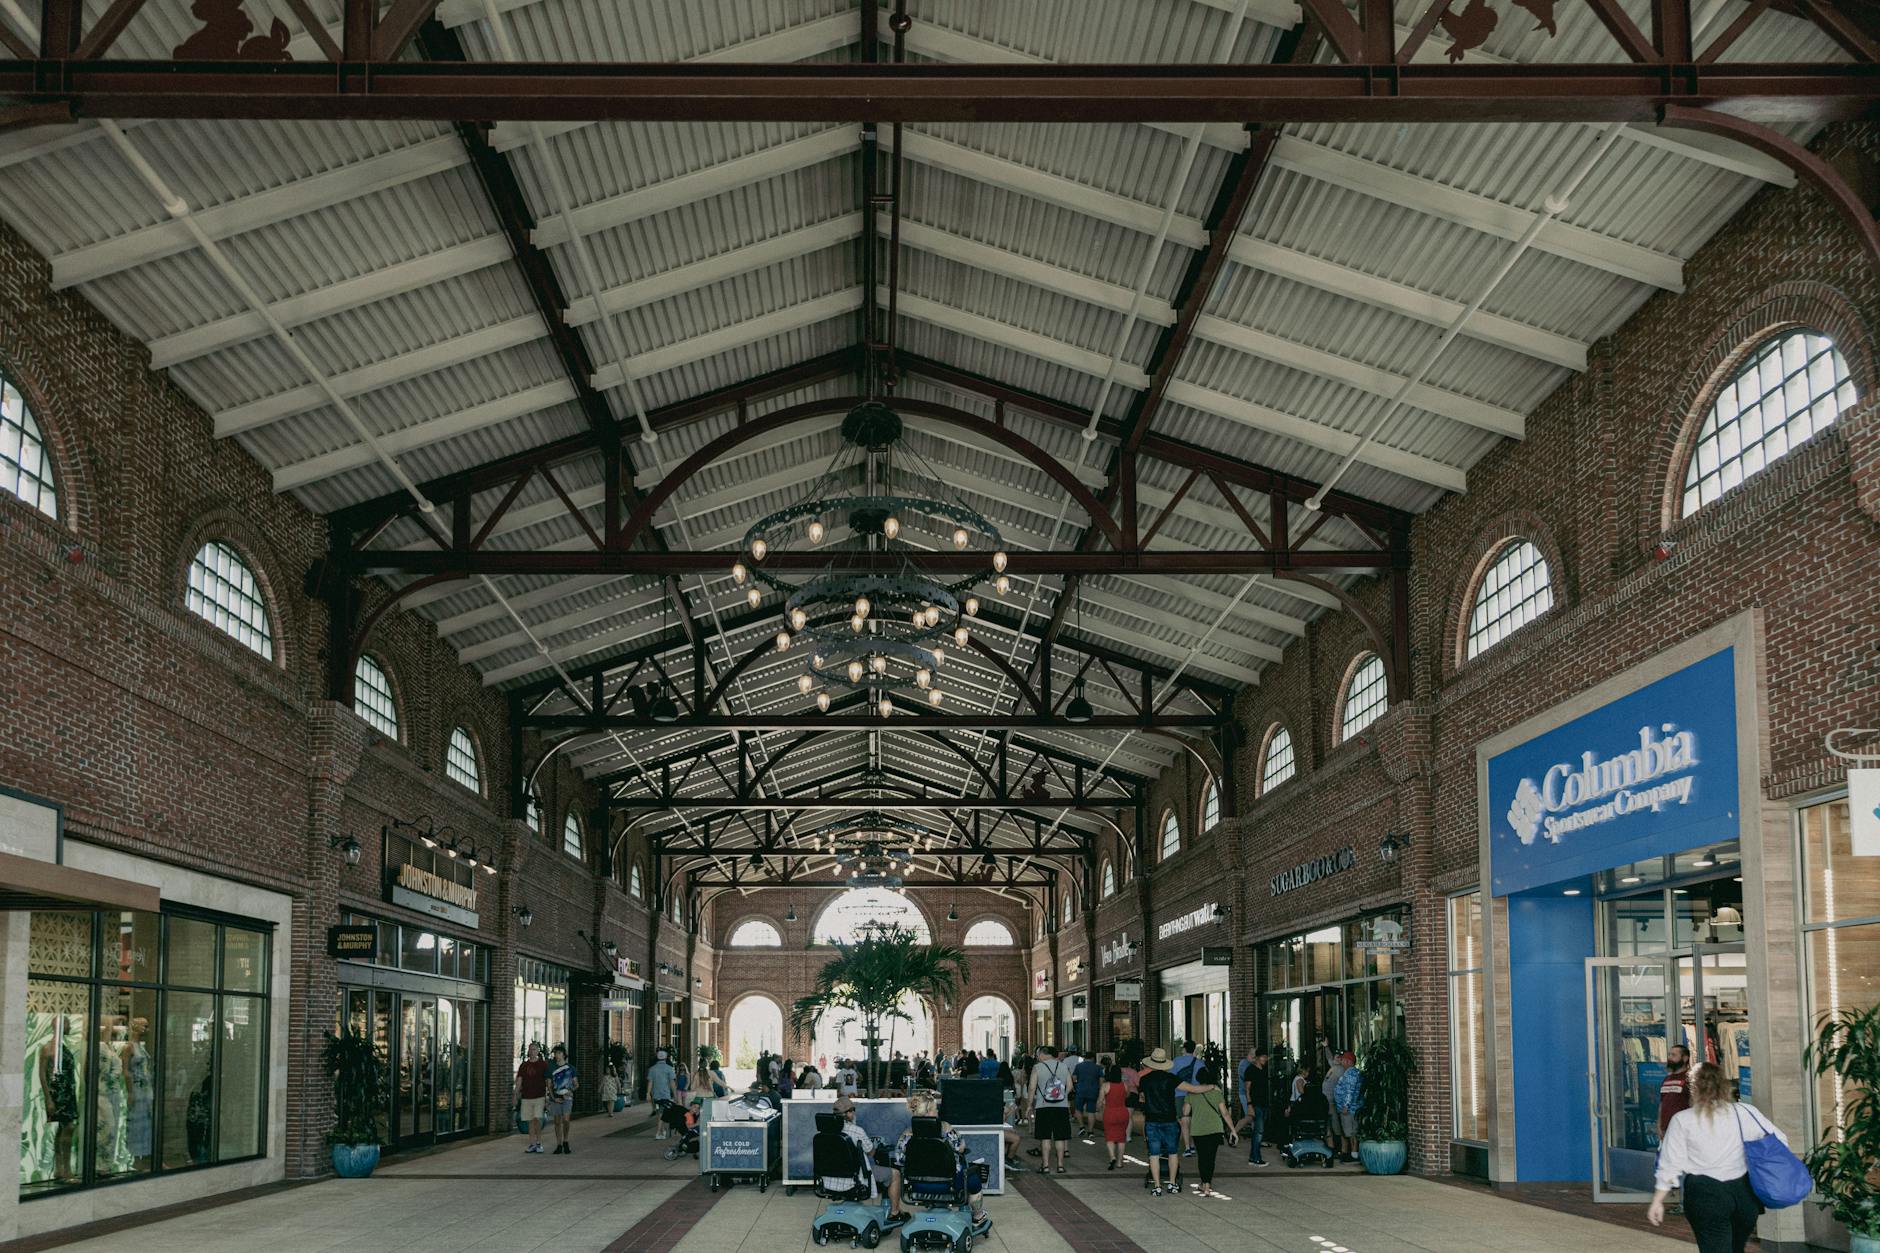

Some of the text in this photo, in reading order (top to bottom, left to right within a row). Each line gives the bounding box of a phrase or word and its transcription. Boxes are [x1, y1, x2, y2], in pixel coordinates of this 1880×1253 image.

[1543, 723, 1696, 812] Columbia
[1544, 776, 1695, 844] Sportswear Company
[337, 933, 373, 942] JOHNSTON
[714, 1146, 760, 1158] Refreshment
